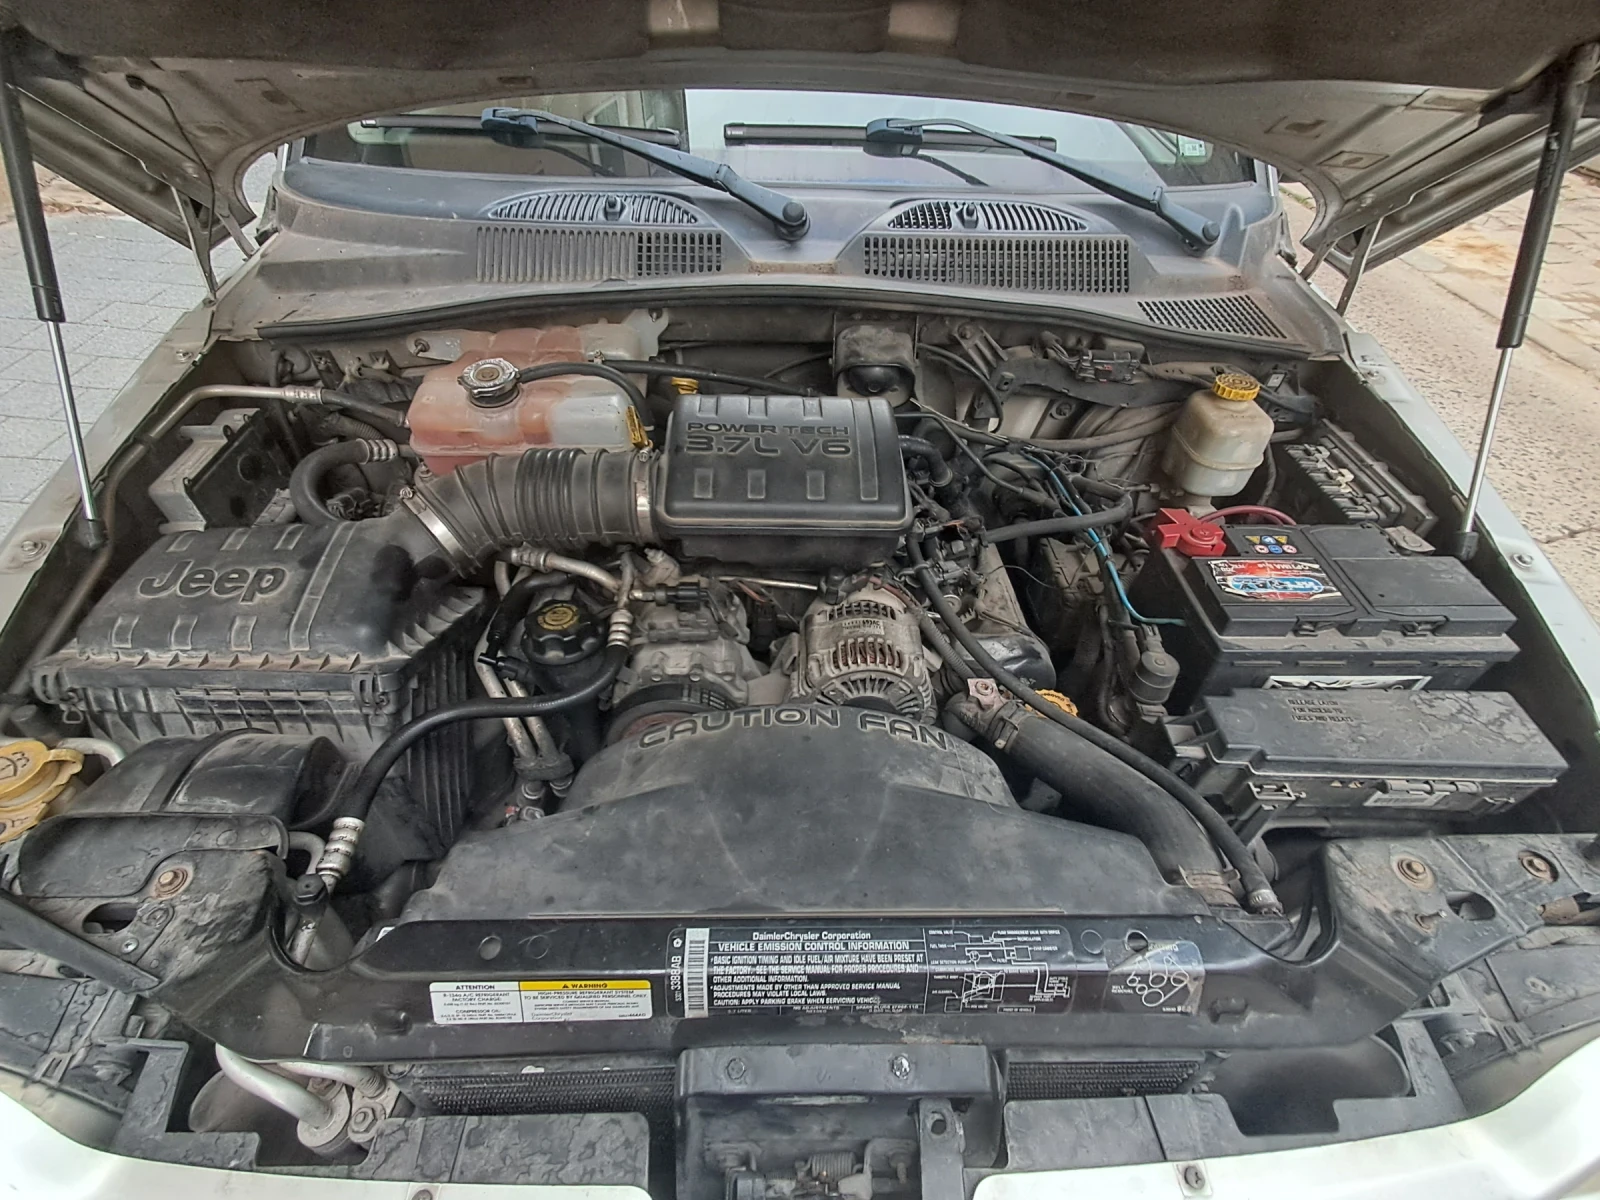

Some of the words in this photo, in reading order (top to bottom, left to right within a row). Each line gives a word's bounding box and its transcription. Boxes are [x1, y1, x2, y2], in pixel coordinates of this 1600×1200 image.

[686, 422, 778, 434] POWER
[782, 425, 849, 435] TECH
[684, 434, 779, 456] 3.7L
[791, 438, 852, 457] V6
[138, 559, 288, 604] Jeep
[638, 706, 840, 749] CAUTION
[858, 713, 948, 751] FAN
[752, 931, 820, 942] DaimlerChrysler
[822, 930, 871, 941] Corporation
[718, 943, 755, 952] VEHICLE
[758, 942, 802, 951] EMISSION
[804, 942, 846, 951] CONTROL
[848, 942, 910, 950] INFORMATION
[732, 956, 757, 964] IGNITION
[758, 956, 779, 964] TIMING
[780, 955, 792, 964] AND
[793, 955, 806, 964] IDLE
[807, 955, 834, 964] FUEL/AIR
[834, 954, 860, 963] MIXTURE
[861, 954, 876, 963] HAVE
[877, 954, 893, 963] BEEN
[894, 954, 915, 963] PRESET
[916, 954, 924, 962] AT
[713, 966, 725, 974] THE
[756, 966, 768, 974] SEE
[768, 966, 780, 974] THE
[780, 966, 804, 974] SERVICE
[806, 965, 830, 974] MANUAL
[831, 965, 842, 973] FOR
[844, 965, 867, 973] PROPER
[867, 965, 905, 973] PROCEDURES
[906, 965, 919, 973] AND
